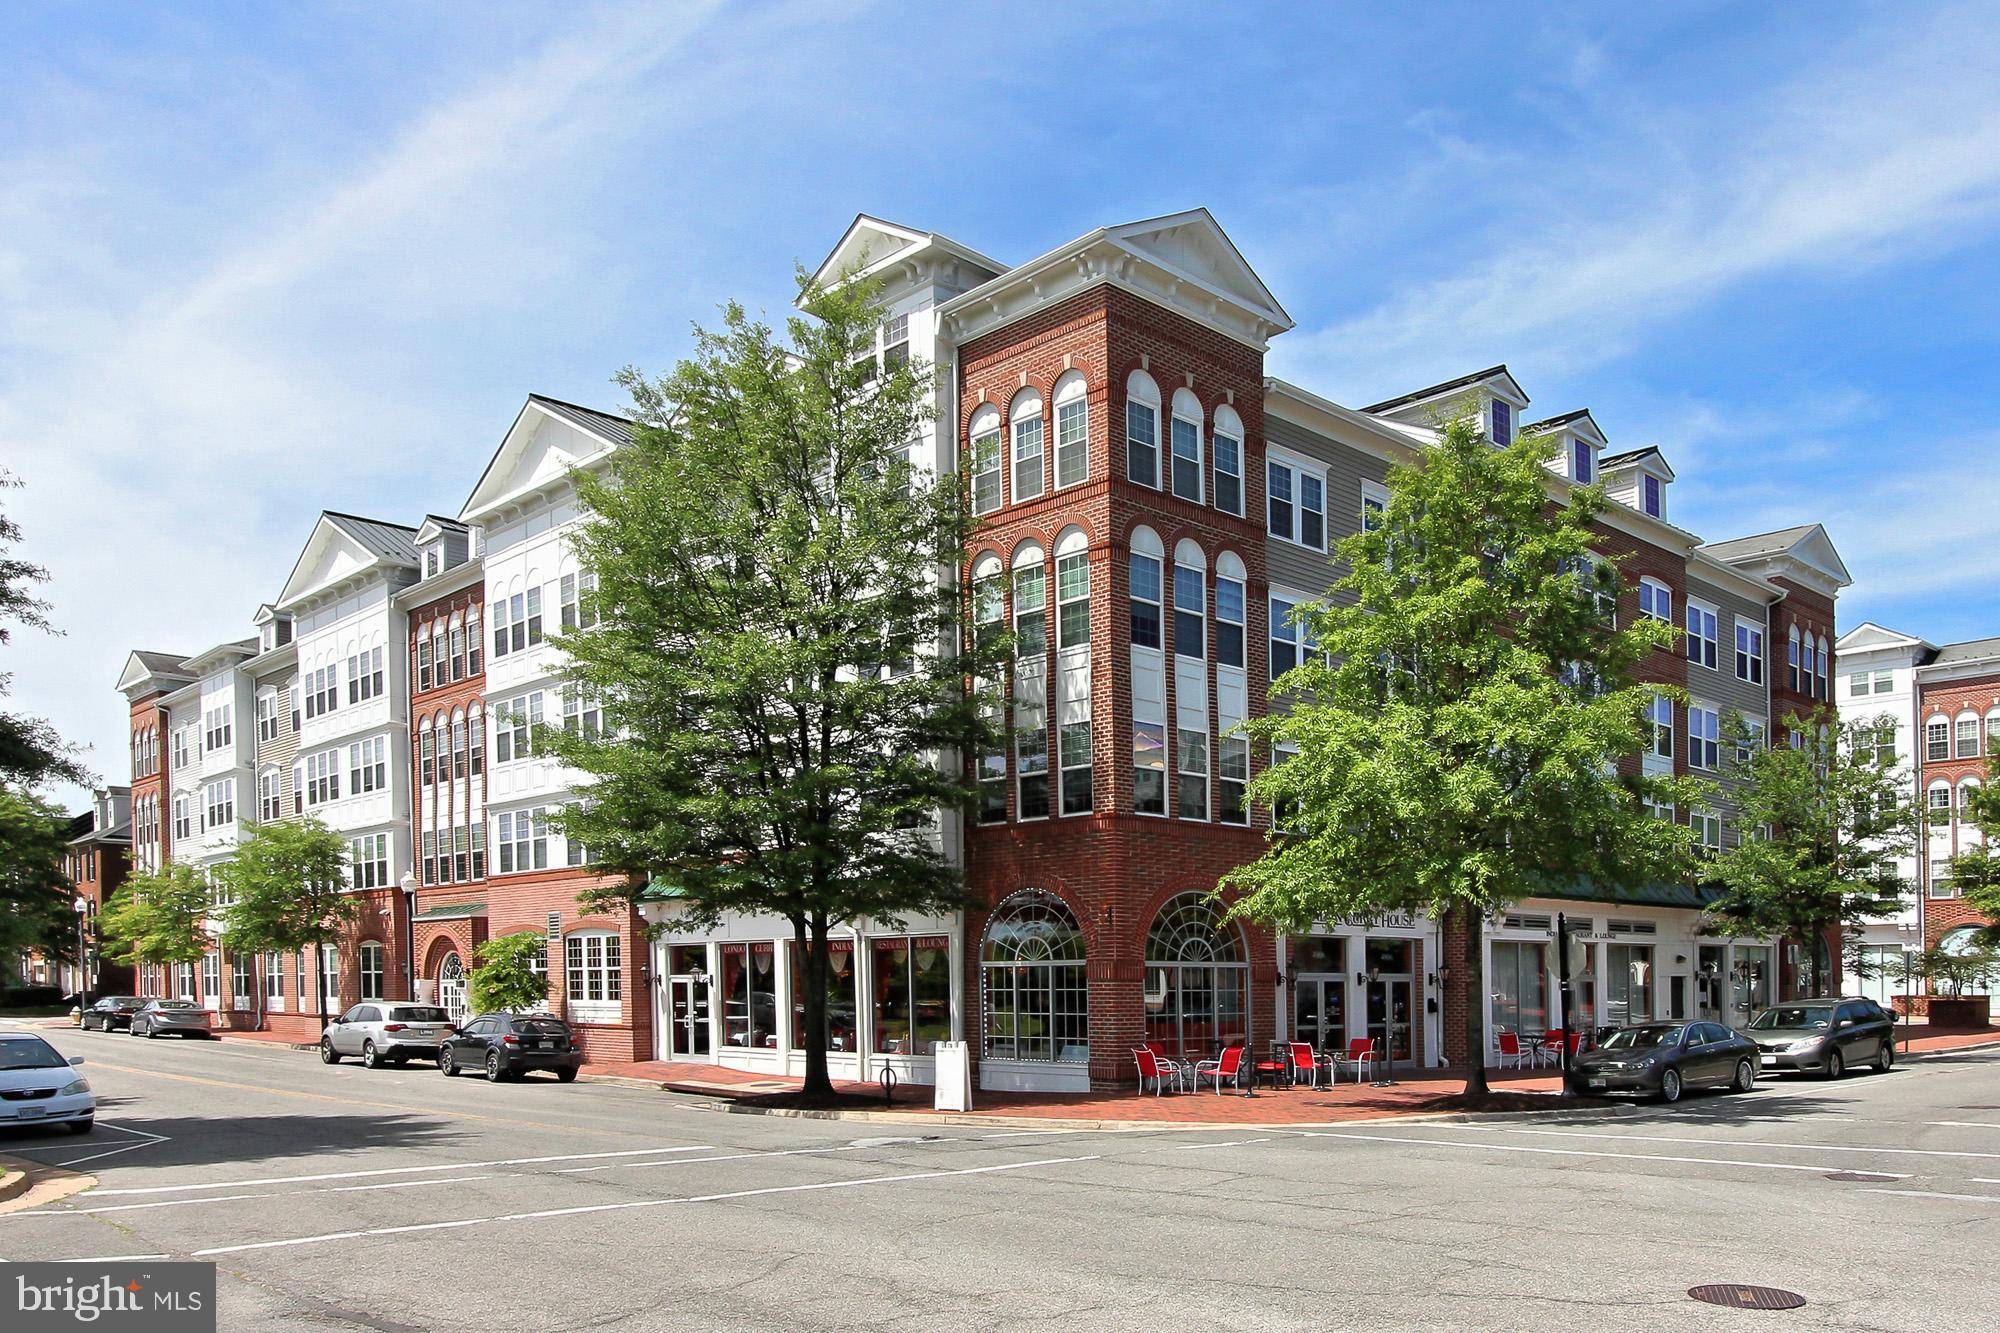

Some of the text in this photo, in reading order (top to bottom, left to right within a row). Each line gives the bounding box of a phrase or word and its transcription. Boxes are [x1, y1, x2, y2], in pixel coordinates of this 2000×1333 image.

[1381, 911, 1416, 929] HOUSE
[724, 943, 774, 953] LONDO CURR
[921, 937, 949, 948] LOUNG
